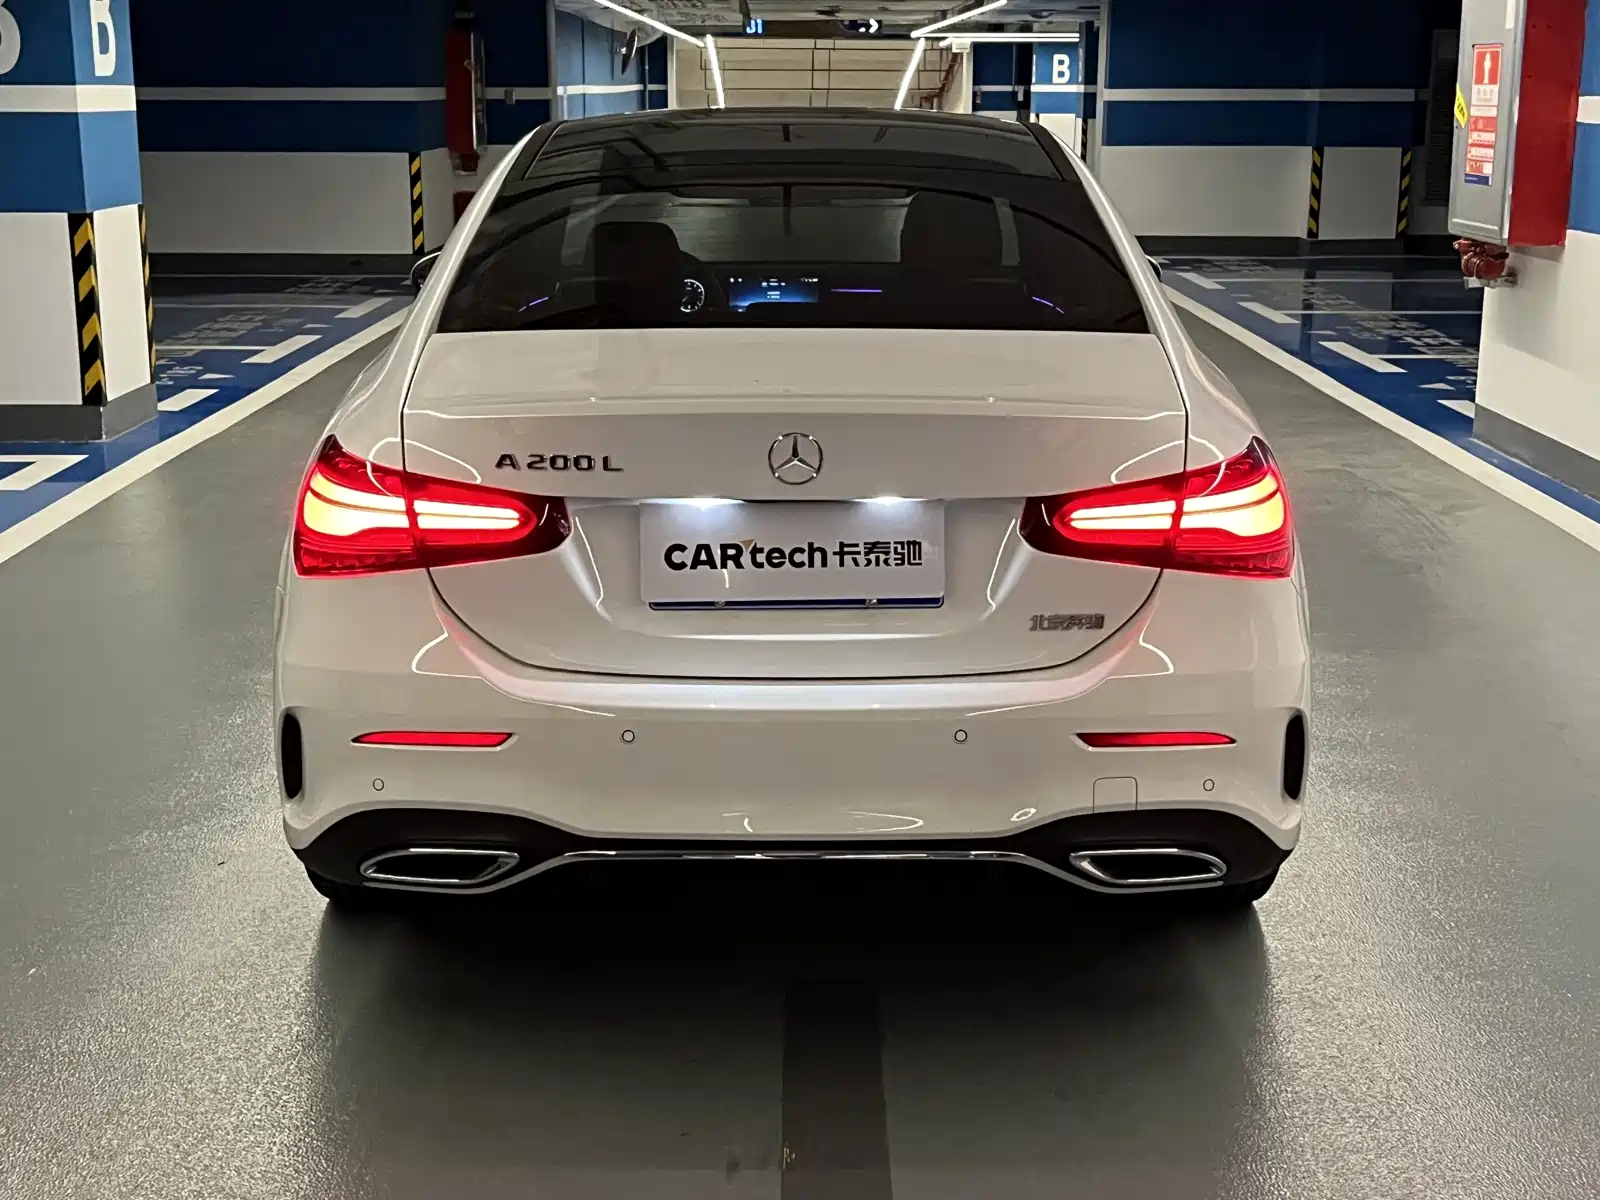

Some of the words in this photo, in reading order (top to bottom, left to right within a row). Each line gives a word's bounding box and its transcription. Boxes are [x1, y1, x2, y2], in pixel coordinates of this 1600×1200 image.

[1052, 54, 1071, 84] B
[495, 453, 521, 471] A
[526, 453, 596, 472] 200
[602, 455, 624, 472] L
[664, 541, 828, 571] CARtech
[833, 540, 923, 567] 卡泰驰
